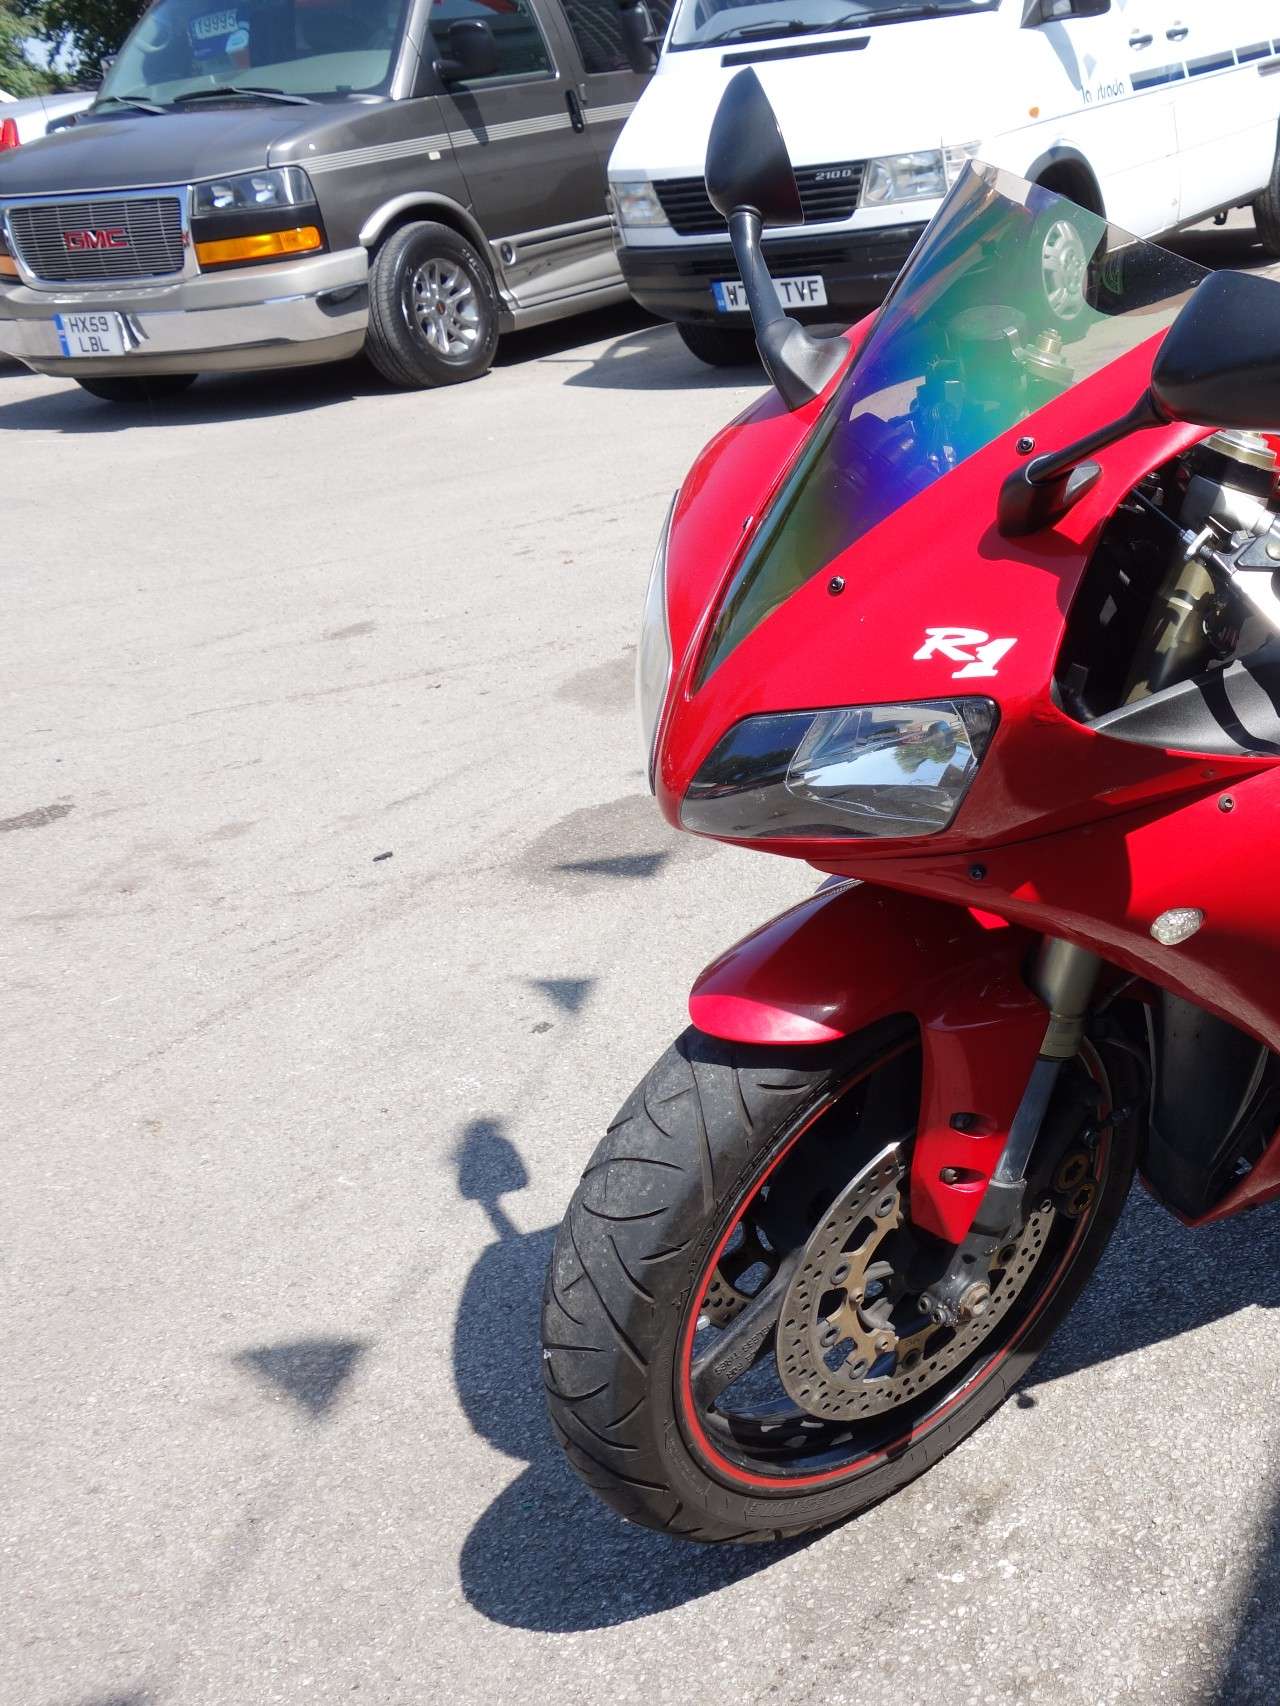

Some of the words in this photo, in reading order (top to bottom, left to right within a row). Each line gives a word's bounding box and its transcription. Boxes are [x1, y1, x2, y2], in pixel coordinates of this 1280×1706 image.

[63, 227, 129, 251] GMC
[780, 280, 819, 303] TVF
[68, 315, 110, 333] HX59
[78, 335, 110, 353] LBL
[912, 627, 1018, 679] R1
